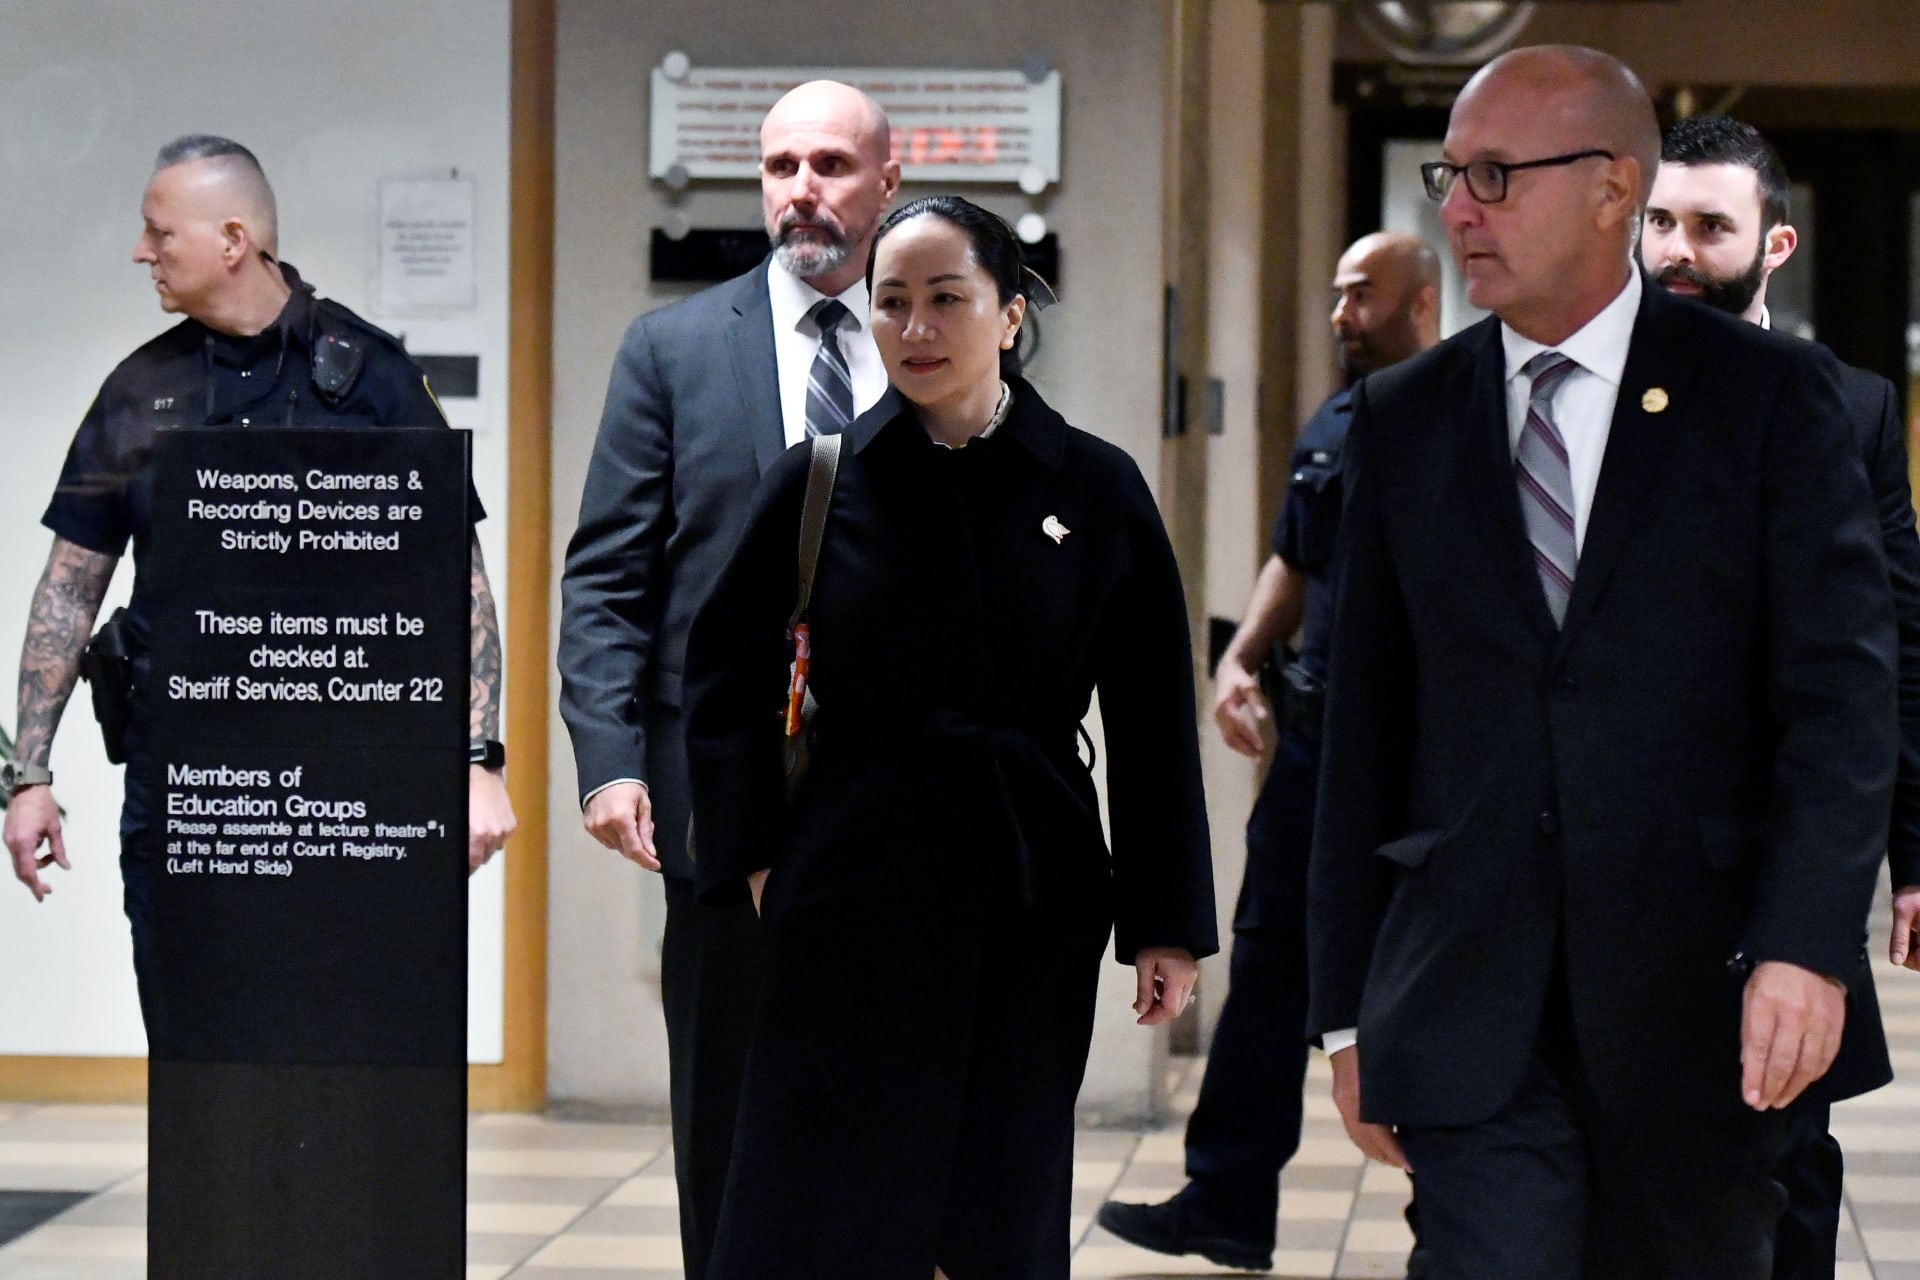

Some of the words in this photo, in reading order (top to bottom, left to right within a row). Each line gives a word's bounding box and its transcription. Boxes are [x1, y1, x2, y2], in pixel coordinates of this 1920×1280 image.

[196, 469, 298, 492] Weapons,
[306, 469, 399, 490] Cameras
[407, 470, 423, 490] &
[189, 499, 291, 523] Recording
[298, 500, 380, 520] Devices
[388, 505, 422, 520] are
[221, 529, 291, 553] Strictly
[300, 530, 399, 550] Prohibited
[195, 610, 262, 634] These
[271, 612, 328, 635] items
[336, 614, 388, 635] must
[396, 612, 424, 635] be
[250, 645, 336, 668] checked
[169, 676, 230, 699] Sheriff
[236, 676, 322, 702] Services,
[328, 677, 404, 701] Counter
[410, 677, 443, 701] 212
[168, 764, 271, 787] Members
[279, 766, 302, 787] of
[168, 794, 277, 816] Education
[285, 796, 366, 821] Groups
[167, 820, 217, 834] Please
[223, 822, 292, 836] assemble
[298, 823, 313, 836] at
[319, 821, 369, 837] lecture
[167, 841, 182, 854] at
[188, 840, 211, 855] the
[216, 841, 236, 855] far
[240, 842, 268, 856] end
[272, 842, 288, 856] of
[293, 841, 335, 856] Court
[343, 842, 407, 860] Registry.
[167, 858, 203, 874] (Left
[209, 859, 248, 874] Hand
[254, 860, 292, 876] Side)
